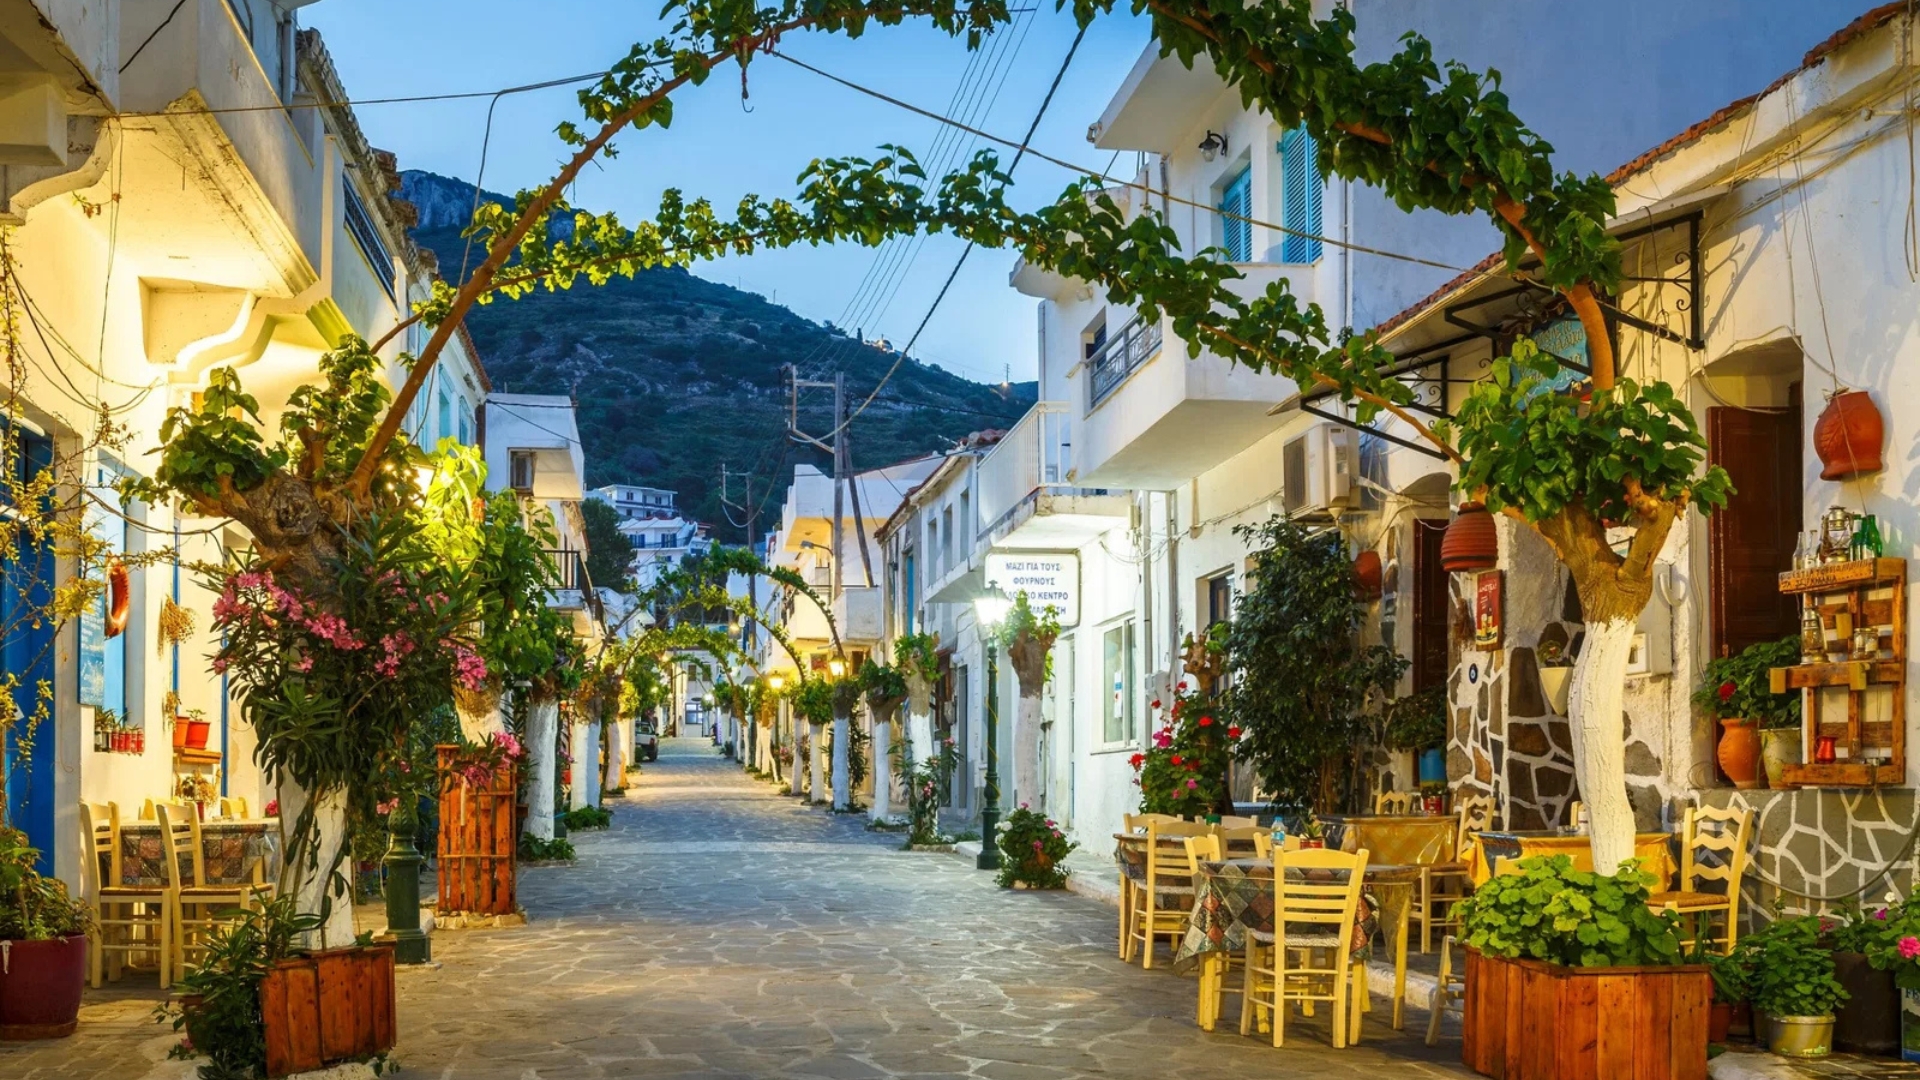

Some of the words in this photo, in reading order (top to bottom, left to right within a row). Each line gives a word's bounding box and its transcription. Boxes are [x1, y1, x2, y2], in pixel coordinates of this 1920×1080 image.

[1006, 563, 1024, 571] ΜΑΖΙ
[1026, 563, 1039, 571] ΓΙΑ
[1040, 563, 1061, 571] ΤΟΥΣ
[1013, 577, 1055, 586] ΦΟΥΡΝΟΥΣ
[1038, 592, 1068, 600] ΚΕΝΤΡΟ
